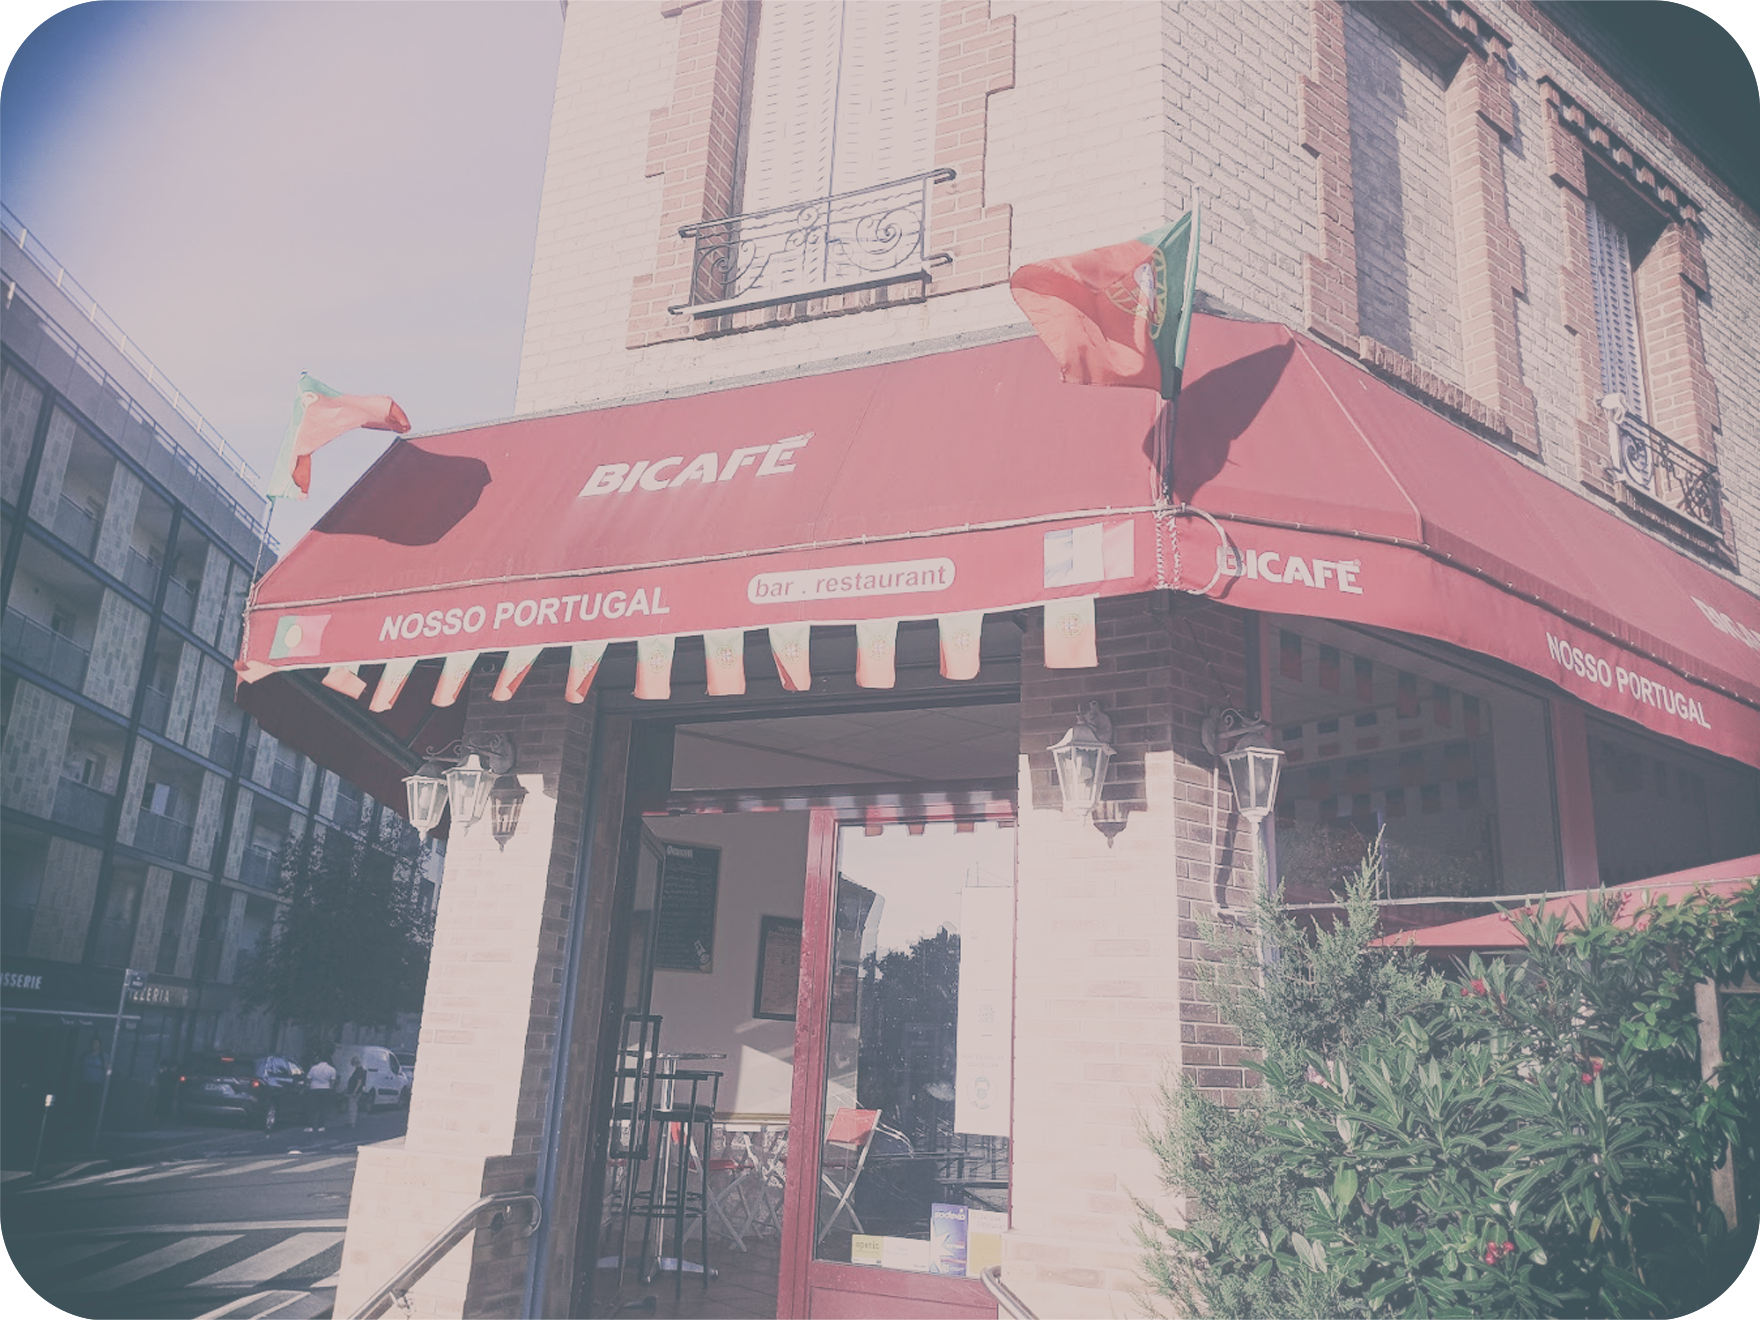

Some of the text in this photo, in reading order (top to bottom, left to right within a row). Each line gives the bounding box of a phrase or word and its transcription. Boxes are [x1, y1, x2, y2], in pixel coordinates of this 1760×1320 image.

[755, 578, 794, 598] bar
[816, 565, 947, 594] restaurant
[379, 587, 670, 641] NOSSO PORTUGAL
[1545, 631, 1712, 729] NOSSO PORTUGAL
